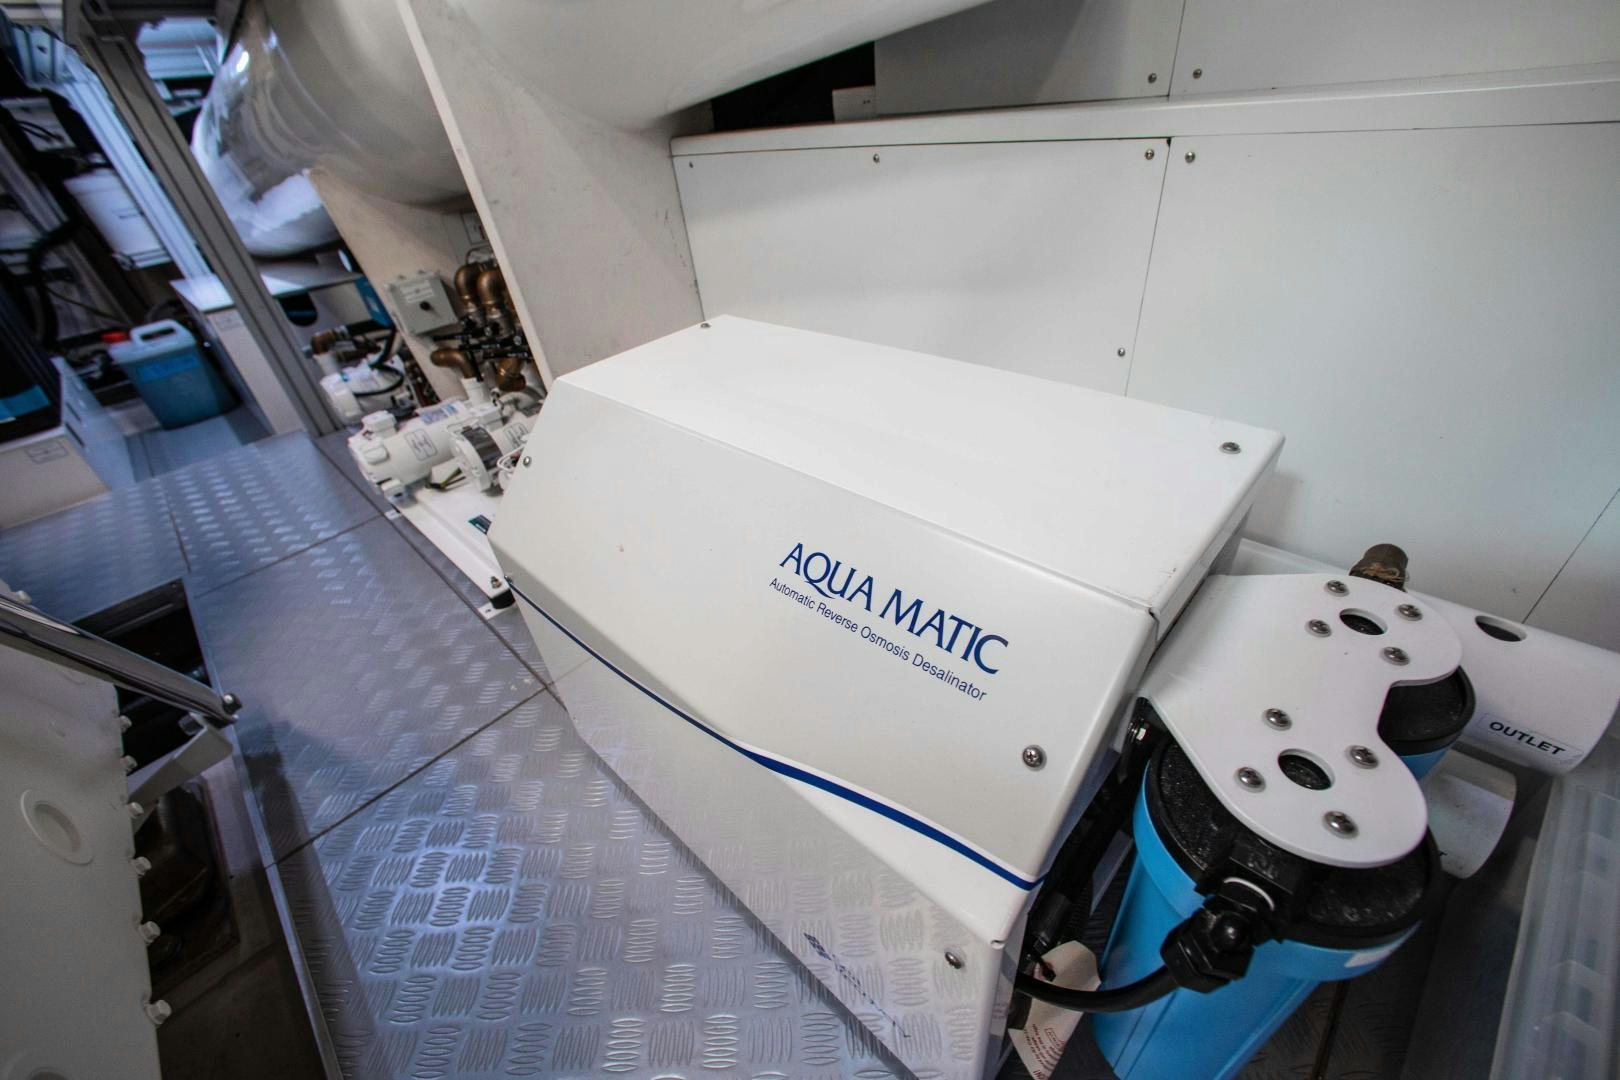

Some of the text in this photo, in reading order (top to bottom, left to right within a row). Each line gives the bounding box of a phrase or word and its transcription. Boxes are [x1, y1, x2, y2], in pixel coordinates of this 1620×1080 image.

[769, 577, 988, 702] Automatic Reverse Osmosis Desalinator
[779, 542, 1009, 675] AQUA MATIC
[1489, 721, 1565, 755] OUTLET
